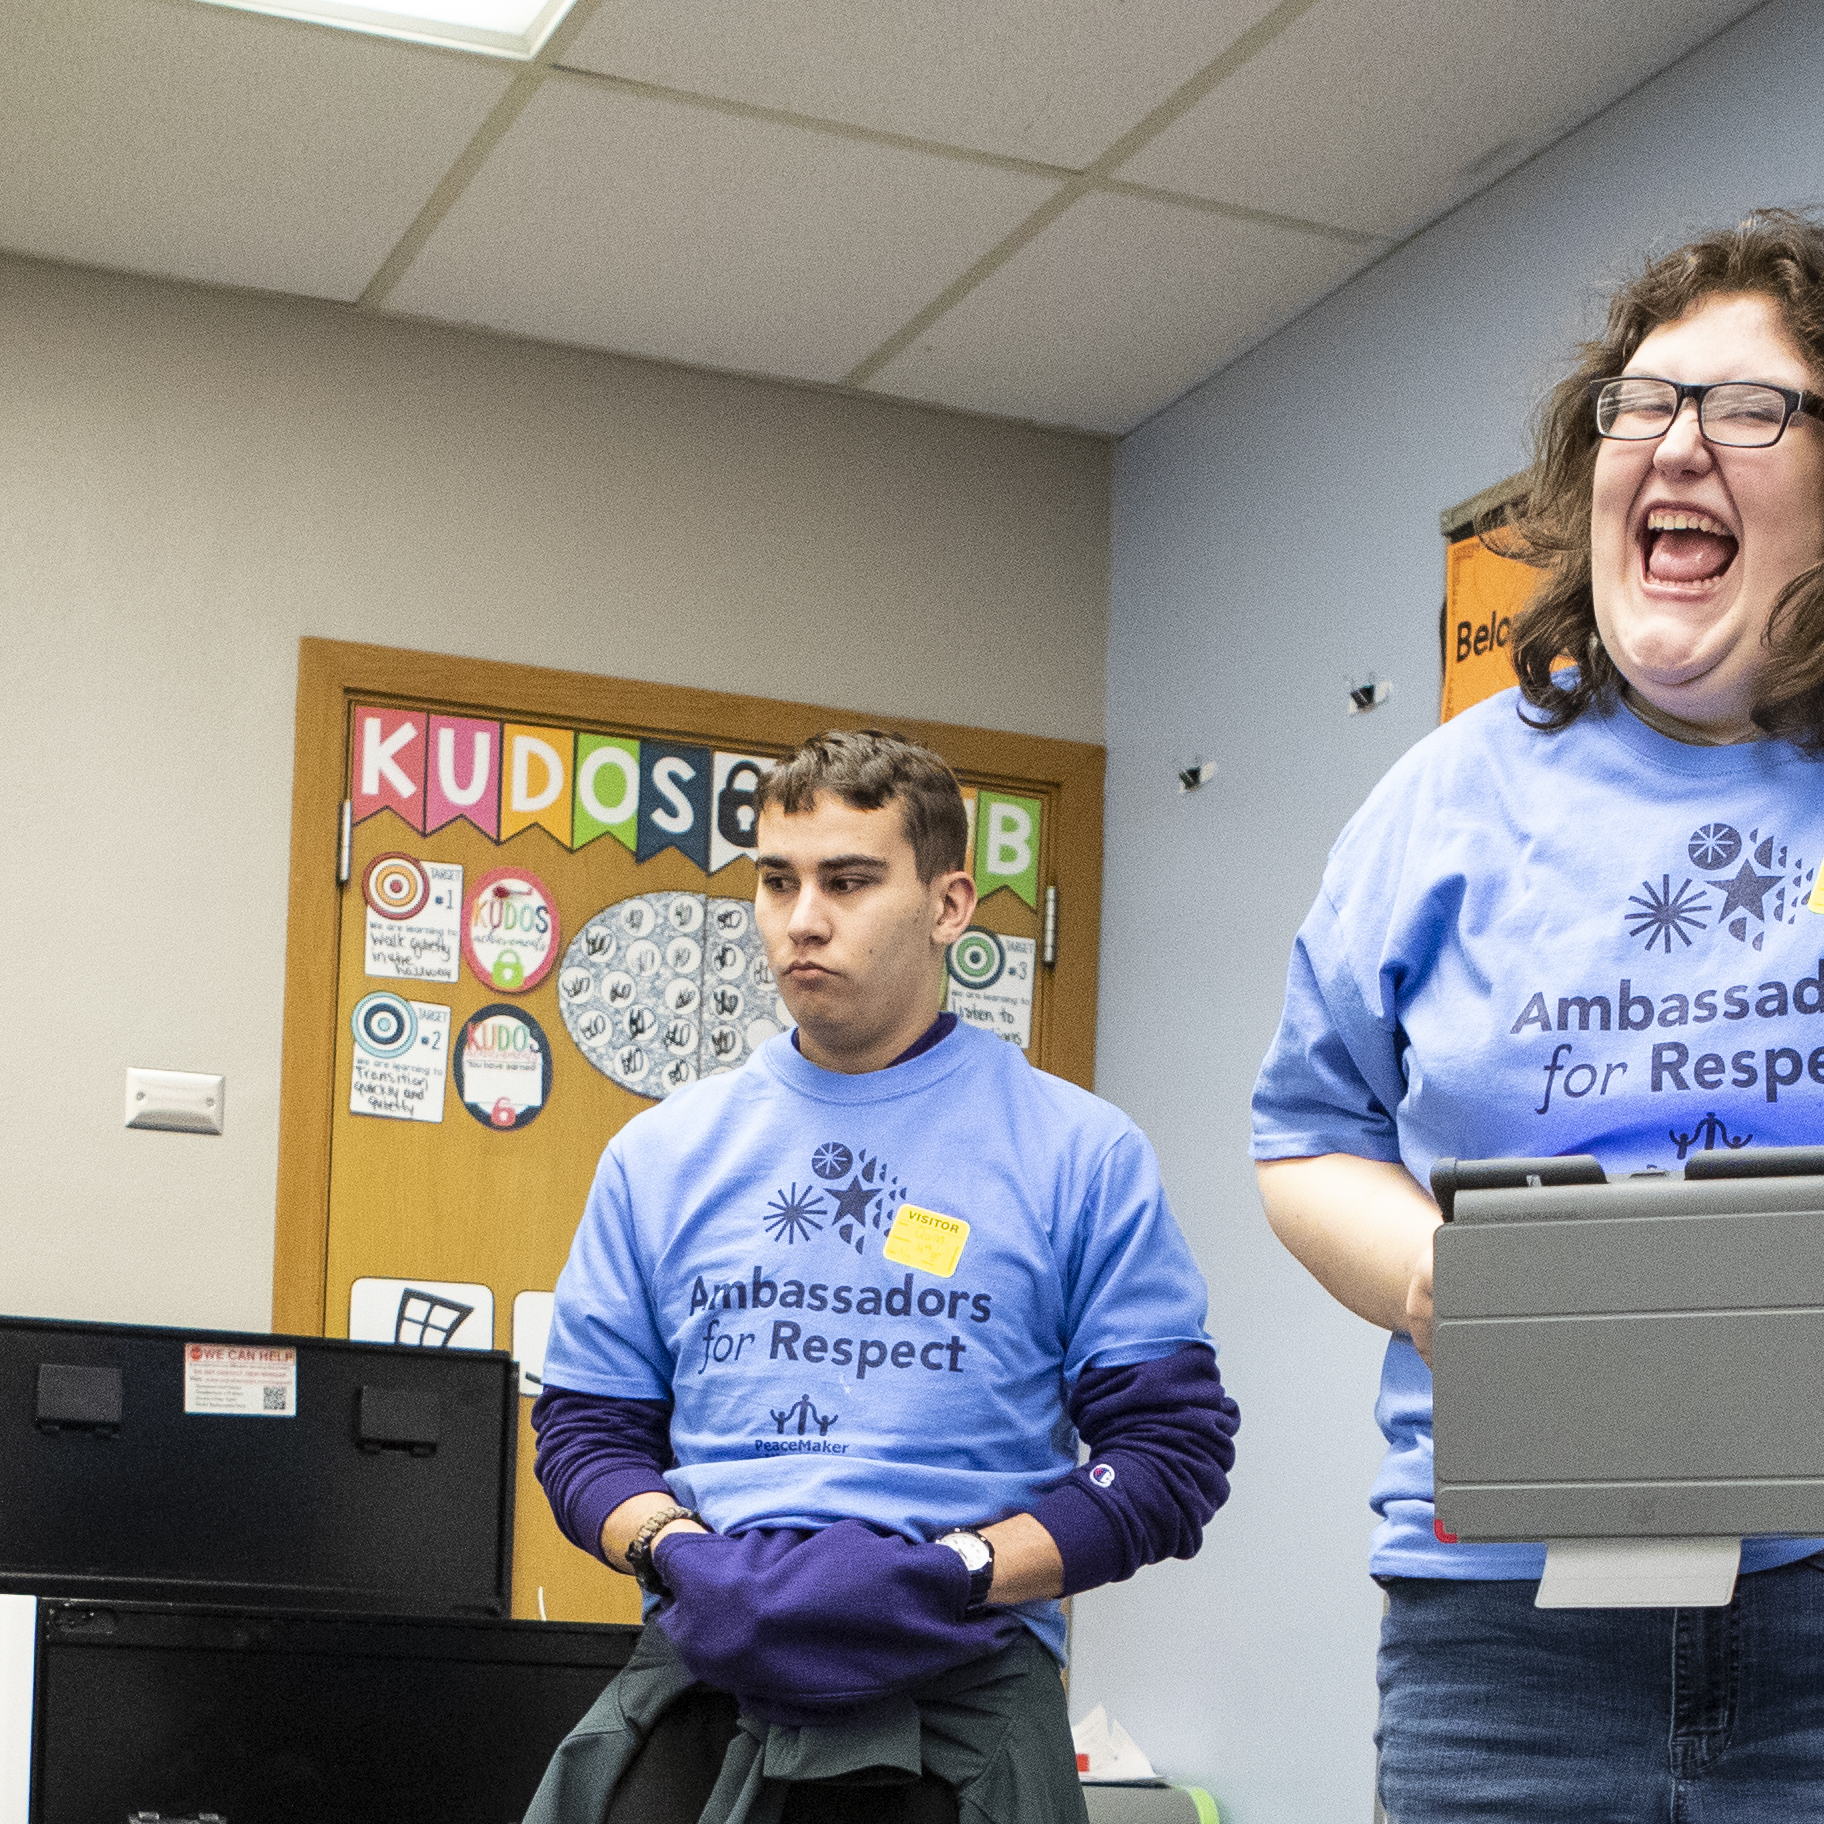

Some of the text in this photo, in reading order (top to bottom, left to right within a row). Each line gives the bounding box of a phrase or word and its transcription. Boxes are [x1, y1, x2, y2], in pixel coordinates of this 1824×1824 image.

[361, 716, 697, 834] KUDOS
[473, 899, 549, 934] KUDOS
[1535, 1043, 1628, 1115] for
[909, 1210, 959, 1234] VISITOR
[689, 1266, 992, 1323] Ambassadors
[228, 1349, 256, 1361] CAN
[259, 1349, 294, 1363] HELP
[698, 1319, 966, 1380] for Respect
[755, 1439, 849, 1454] PeaceMaker
